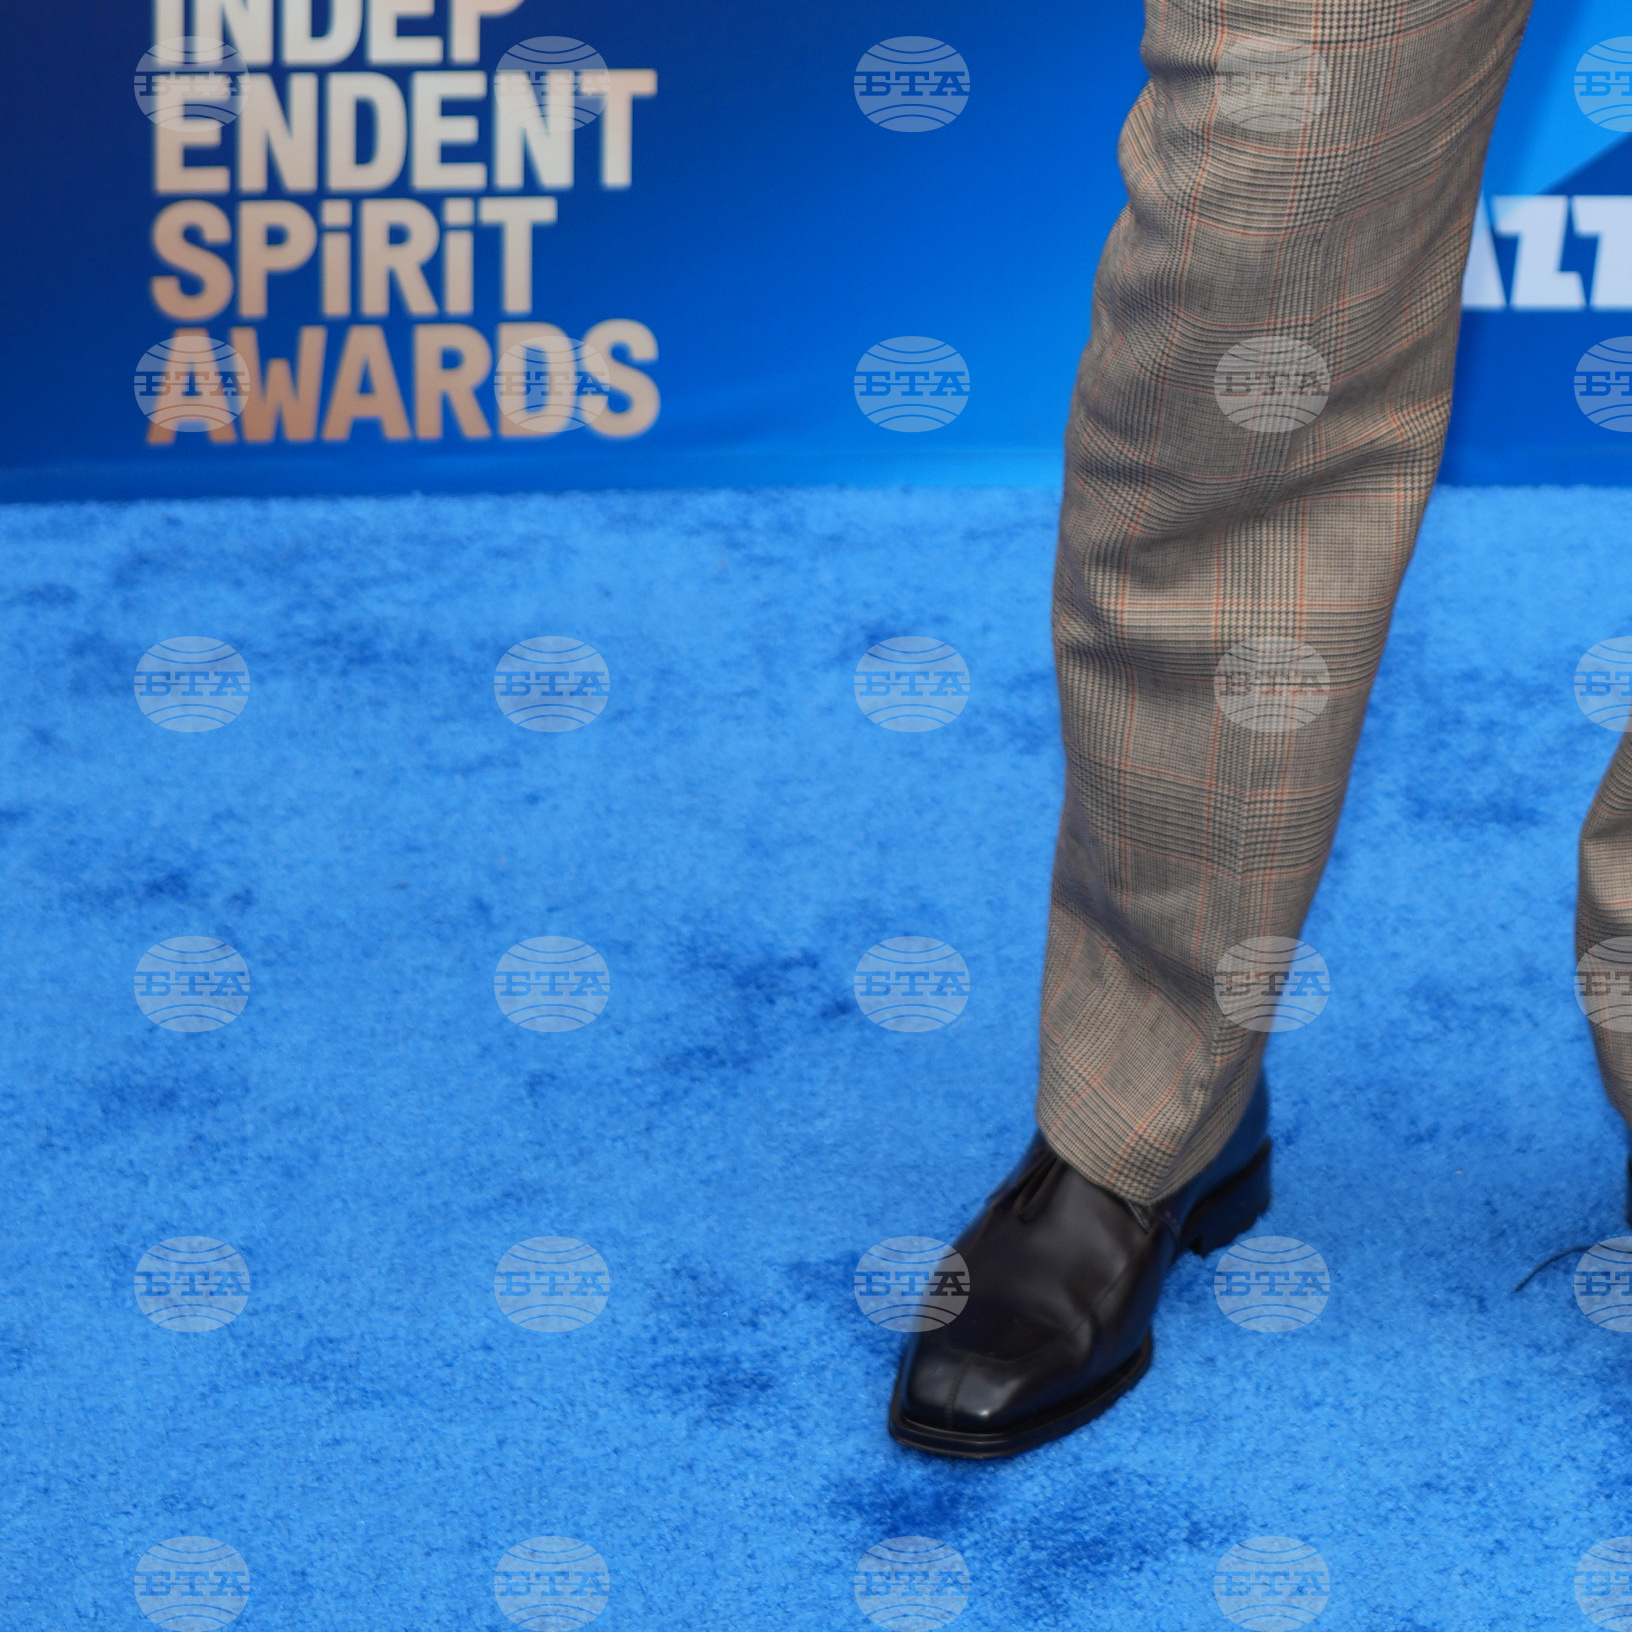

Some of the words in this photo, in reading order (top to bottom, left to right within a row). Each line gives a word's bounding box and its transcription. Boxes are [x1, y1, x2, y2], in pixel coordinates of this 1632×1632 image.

[154, 68, 657, 193] ENDENT
[153, 197, 557, 319] SPiRiT
[151, 319, 659, 442] AWARDS
